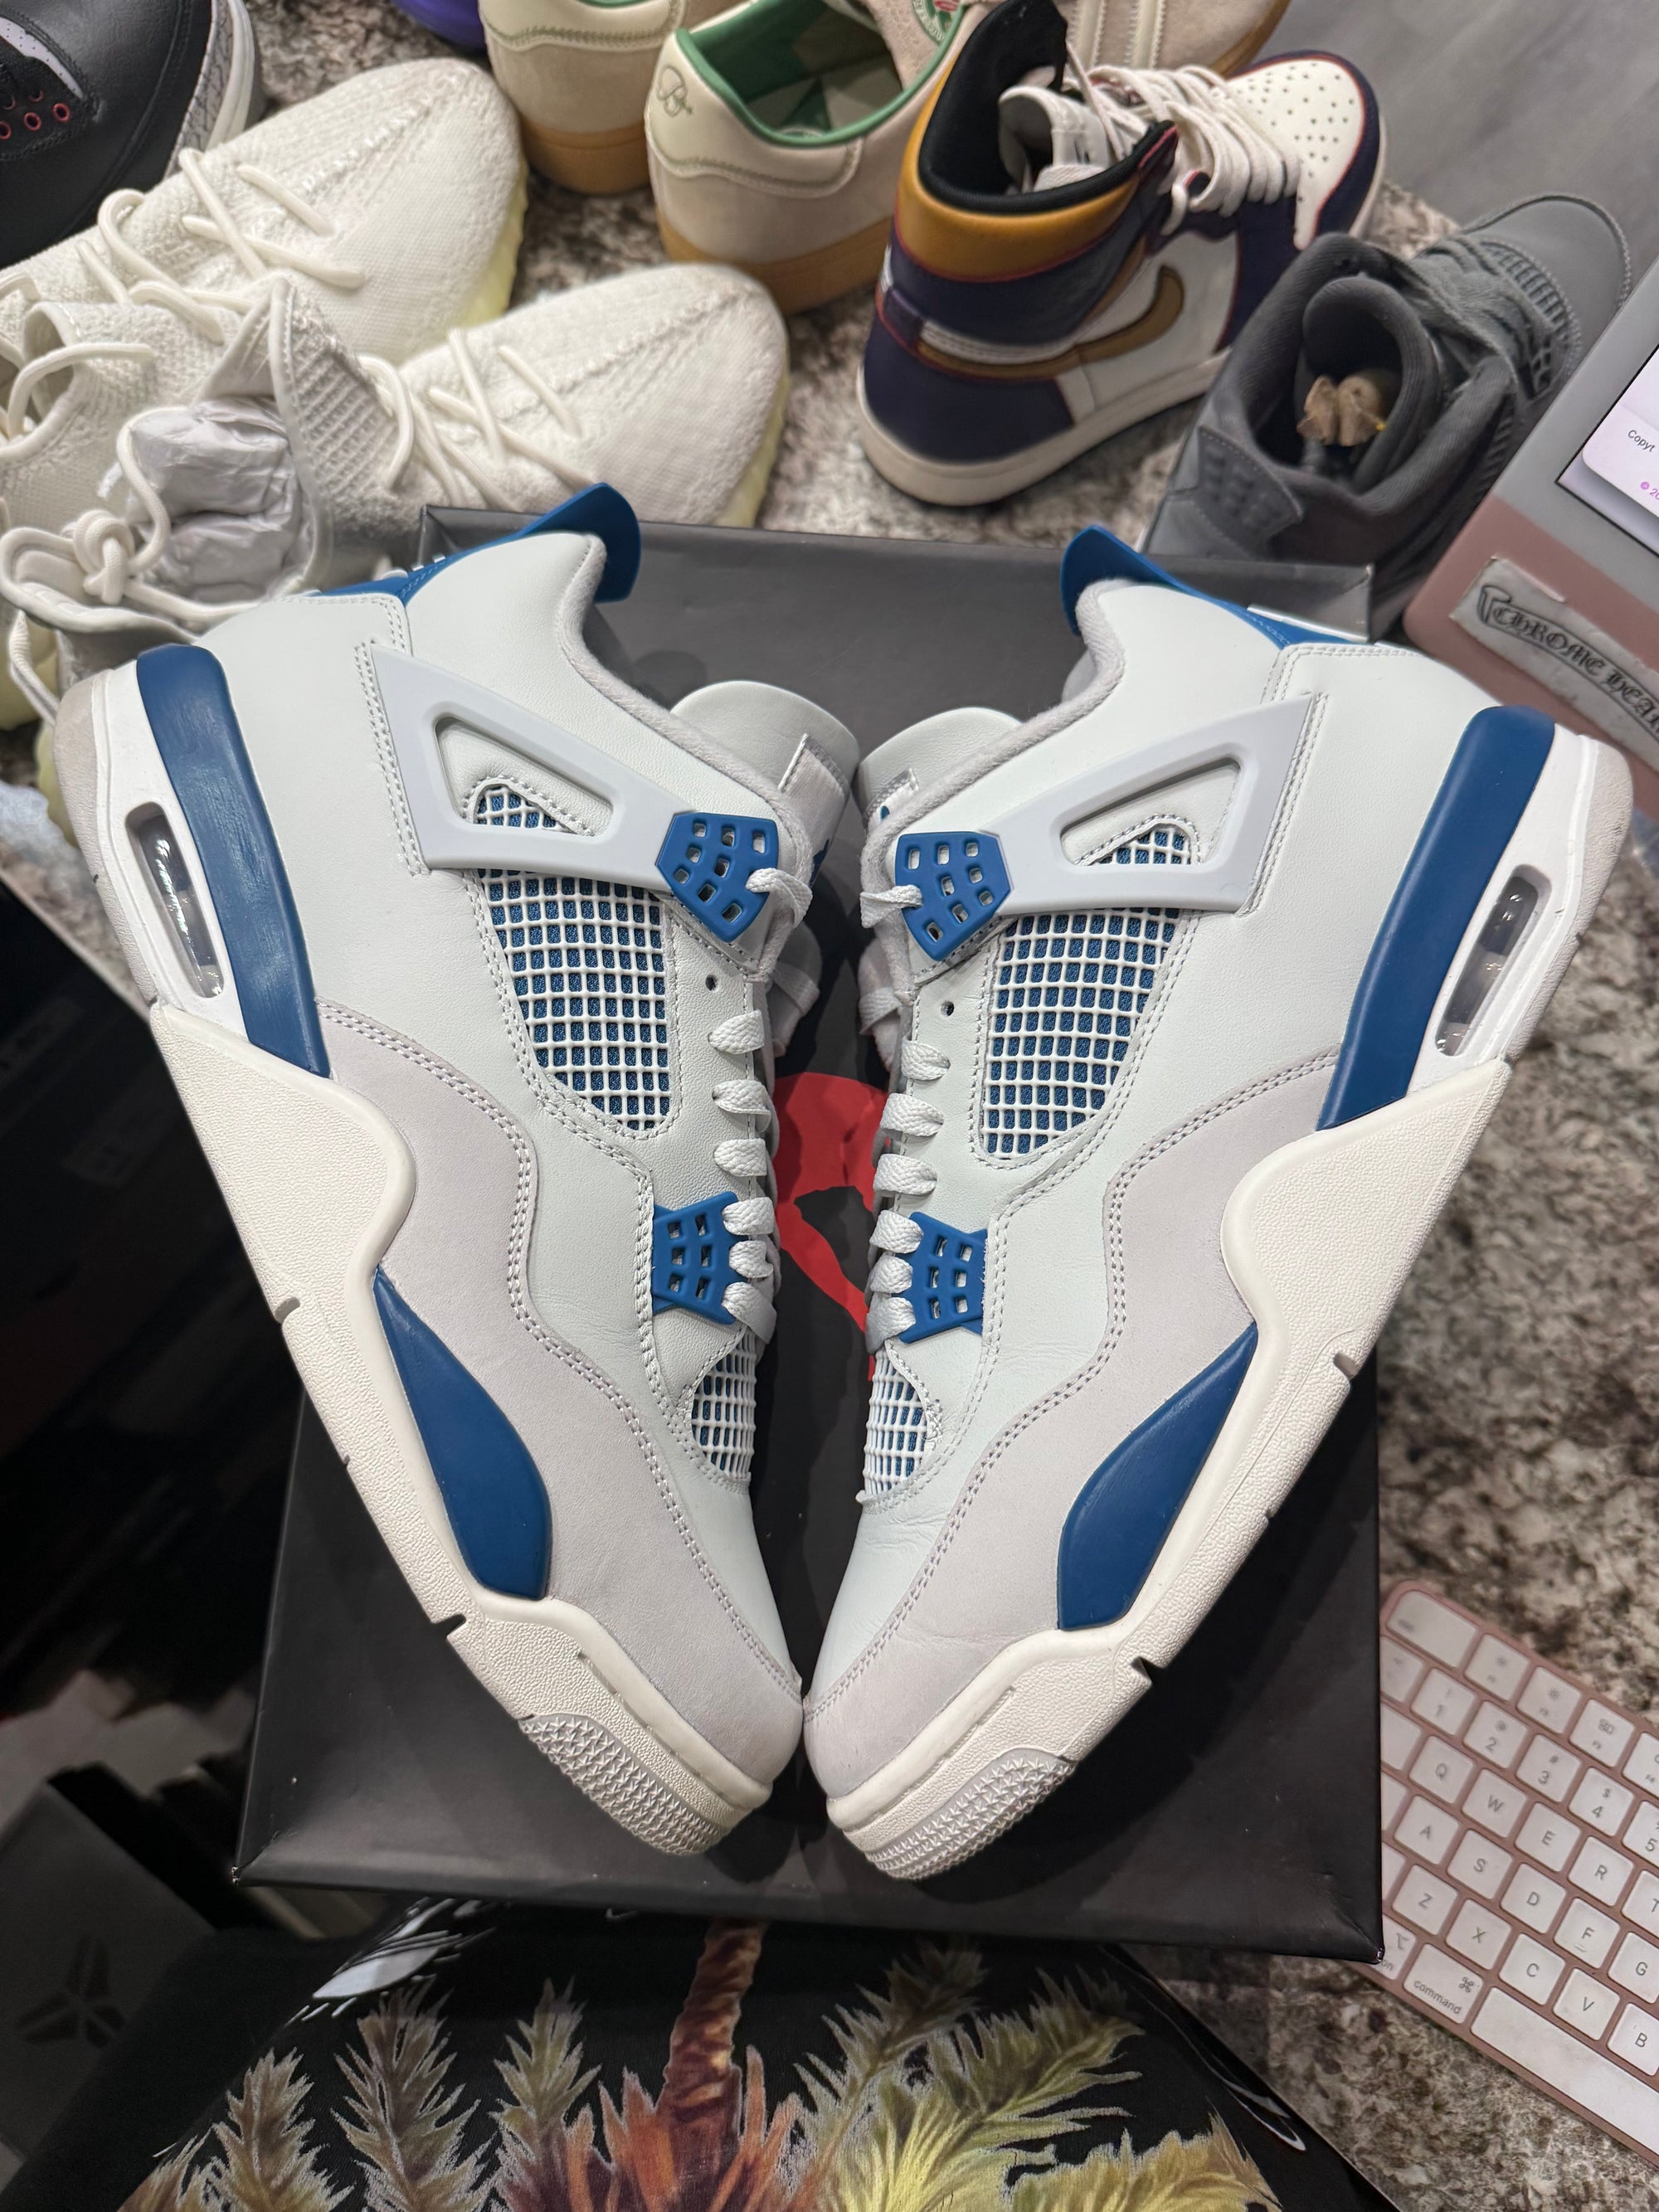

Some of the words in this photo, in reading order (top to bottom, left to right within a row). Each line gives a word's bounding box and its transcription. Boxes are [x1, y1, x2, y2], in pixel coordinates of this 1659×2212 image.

[1627, 430, 1656, 453] Copyt
[1485, 1736, 1498, 1753] 2
[1435, 1762, 1447, 1781] Q
[1538, 1770, 1550, 1785] 3
[1487, 1794, 1505, 1812] W
[1592, 1806, 1603, 1819] 4
[1419, 1825, 1432, 1840] A
[1541, 1830, 1555, 1846] E
[1645, 1837, 1658, 1852] 5
[1473, 1858, 1486, 1873] S
[1594, 1864, 1608, 1880] R
[1418, 1893, 1433, 1910] Z
[1526, 1891, 1540, 1906] D
[1471, 1926, 1486, 1943] X
[1581, 1927, 1595, 1939] F
[1526, 1962, 1540, 1977] C
[1635, 1962, 1648, 1976] G
[1413, 1980, 1462, 2015] command
[1583, 1996, 1595, 2012] V
[1634, 2032, 1648, 2048] B
